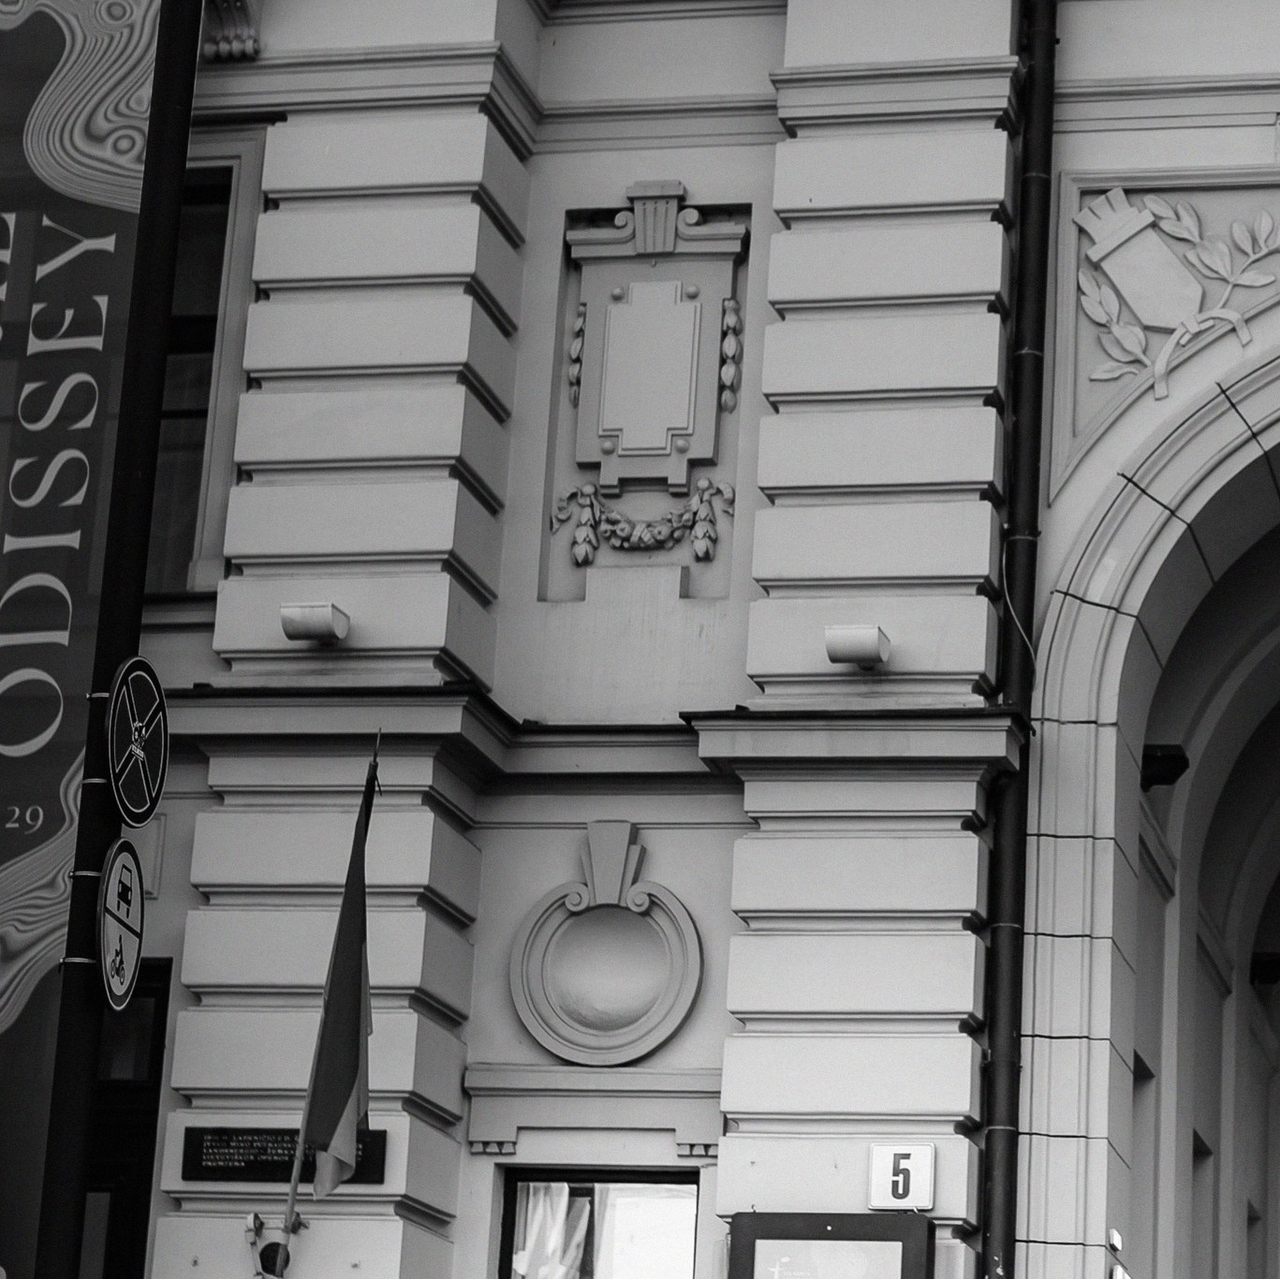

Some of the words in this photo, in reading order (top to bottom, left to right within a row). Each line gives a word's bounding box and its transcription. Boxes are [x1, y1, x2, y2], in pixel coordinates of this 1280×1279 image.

[0, 214, 116, 757] ODISSEY
[5, 805, 44, 835] 29
[891, 1153, 911, 1200] 5
